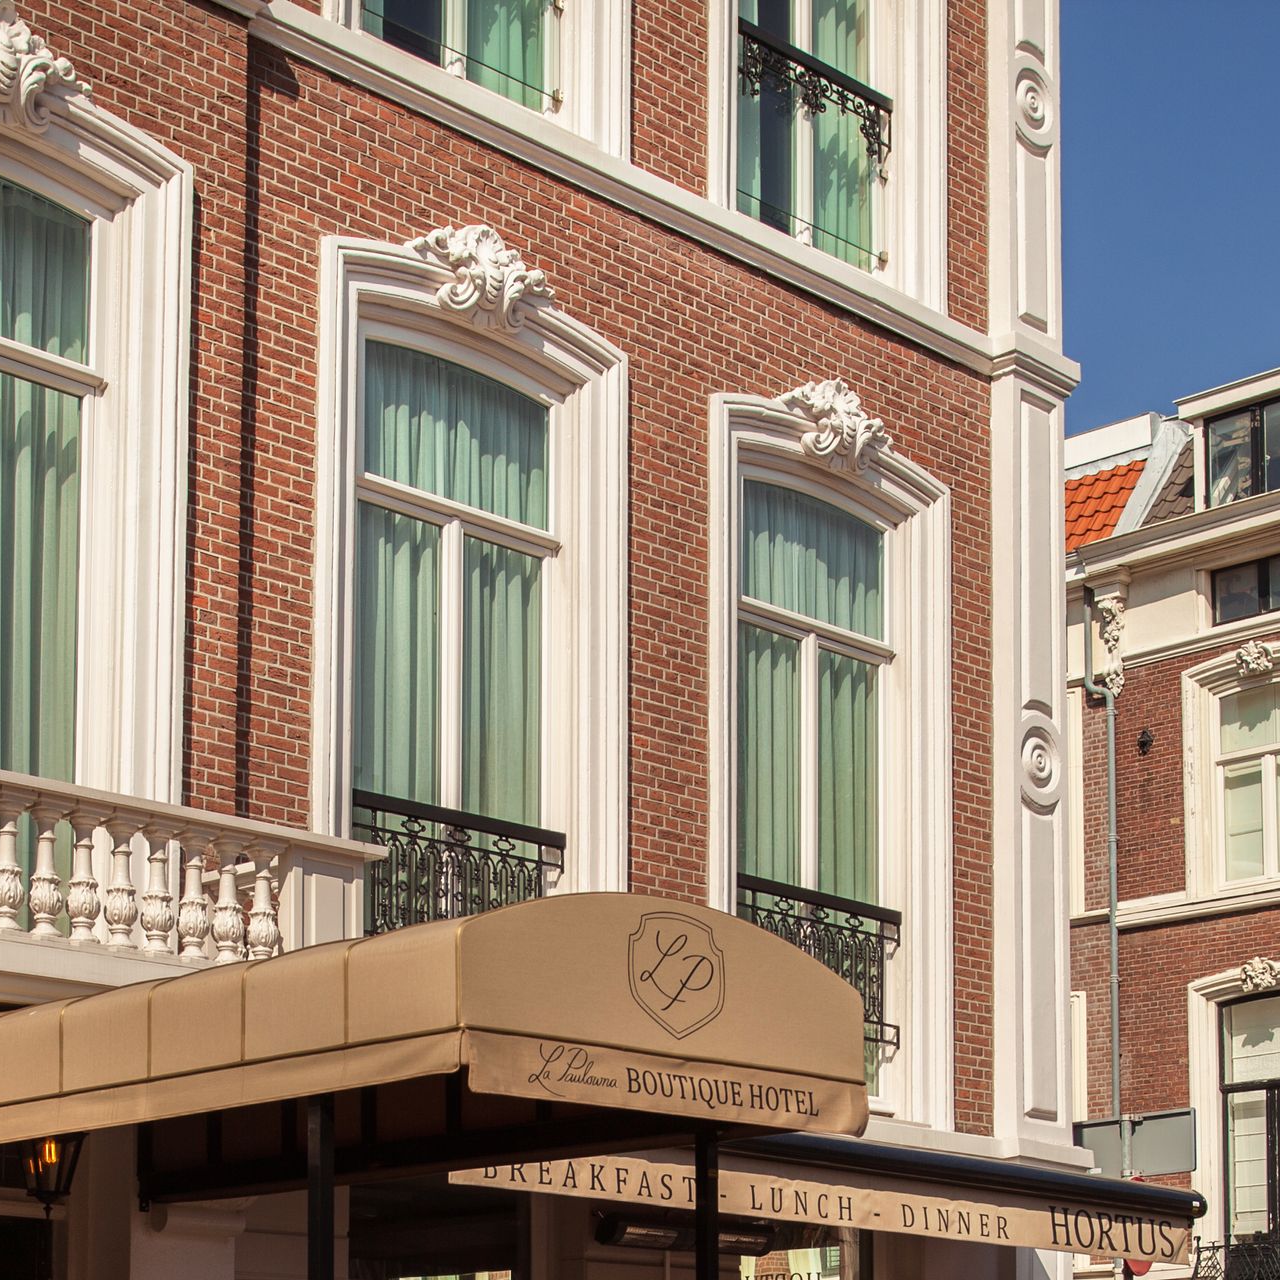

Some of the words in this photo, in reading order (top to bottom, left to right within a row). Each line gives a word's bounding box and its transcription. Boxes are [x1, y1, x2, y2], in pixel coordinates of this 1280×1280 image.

[528, 1043, 566, 1097] La
[557, 1047, 618, 1088] Paulowna
[626, 1067, 744, 1110] BOUTIQUE
[748, 1084, 820, 1117] HOTEL
[750, 1184, 853, 1221] LUNCH
[901, 1203, 1010, 1240] DINNER
[1048, 1205, 1175, 1258] HORTUS
